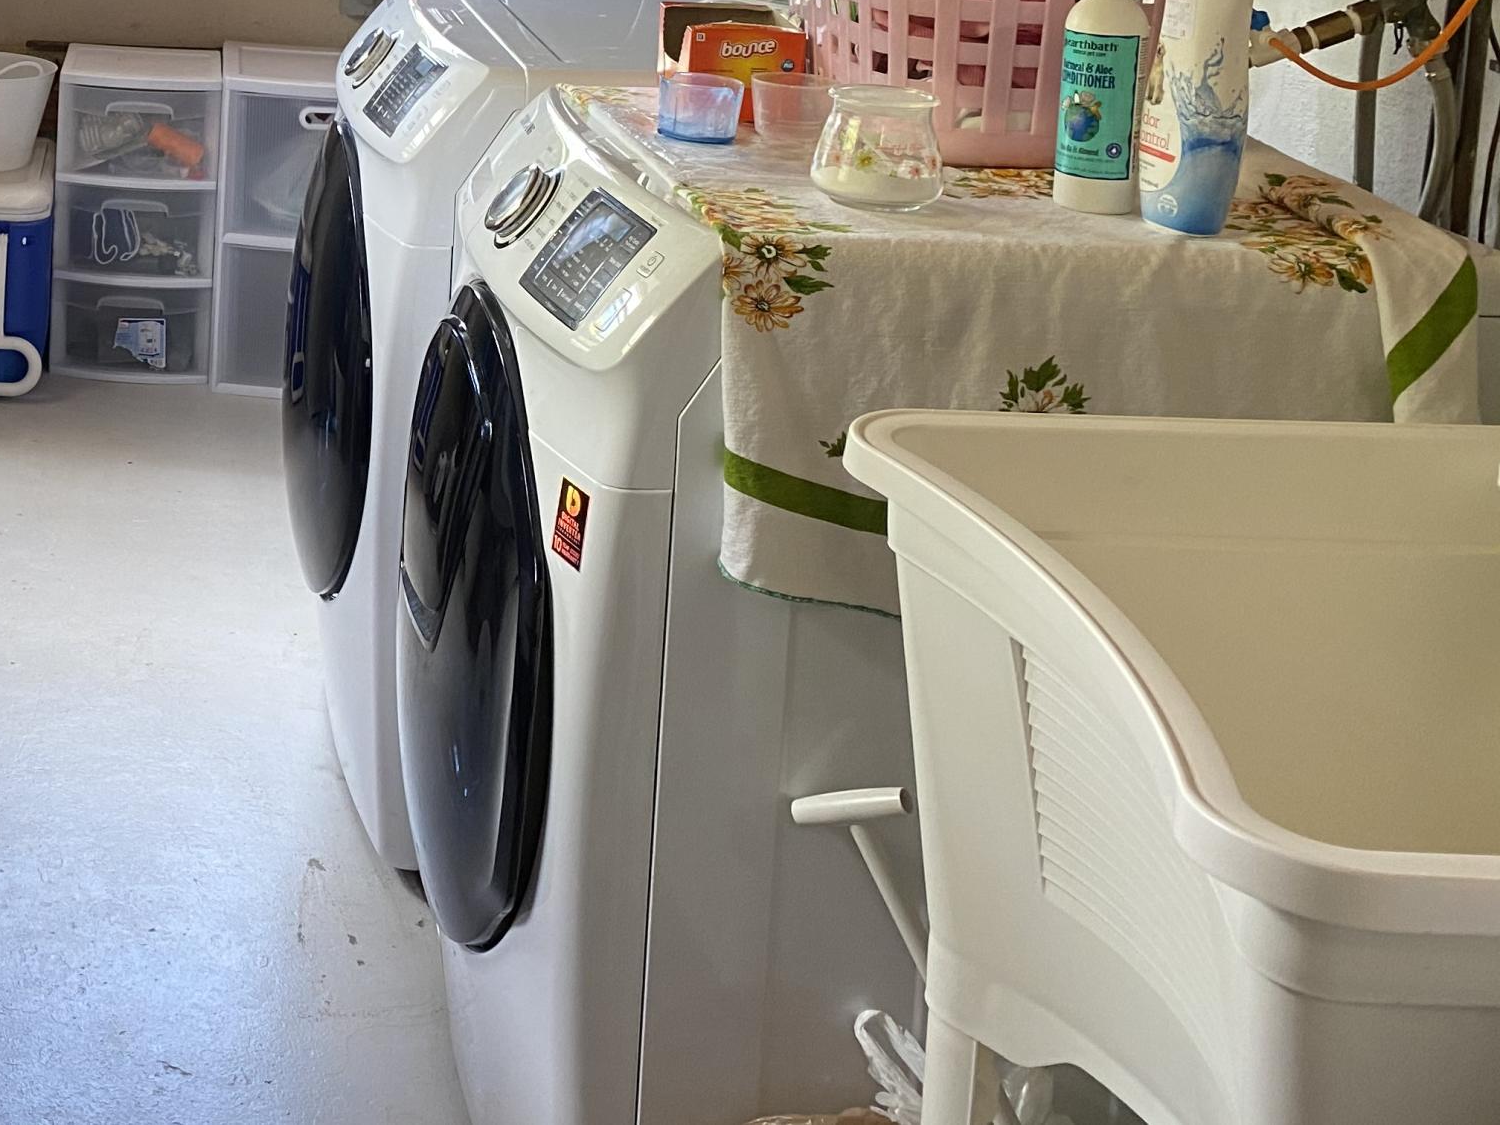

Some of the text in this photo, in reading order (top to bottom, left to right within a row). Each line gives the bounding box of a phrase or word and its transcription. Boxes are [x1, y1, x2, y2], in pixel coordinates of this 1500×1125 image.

[720, 39, 777, 58] bounce
[1085, 62, 1094, 73] &
[1095, 64, 1114, 75] Aloe
[1142, 110, 1162, 130] dor
[1141, 130, 1170, 151] ontrol
[553, 534, 562, 552] 10
